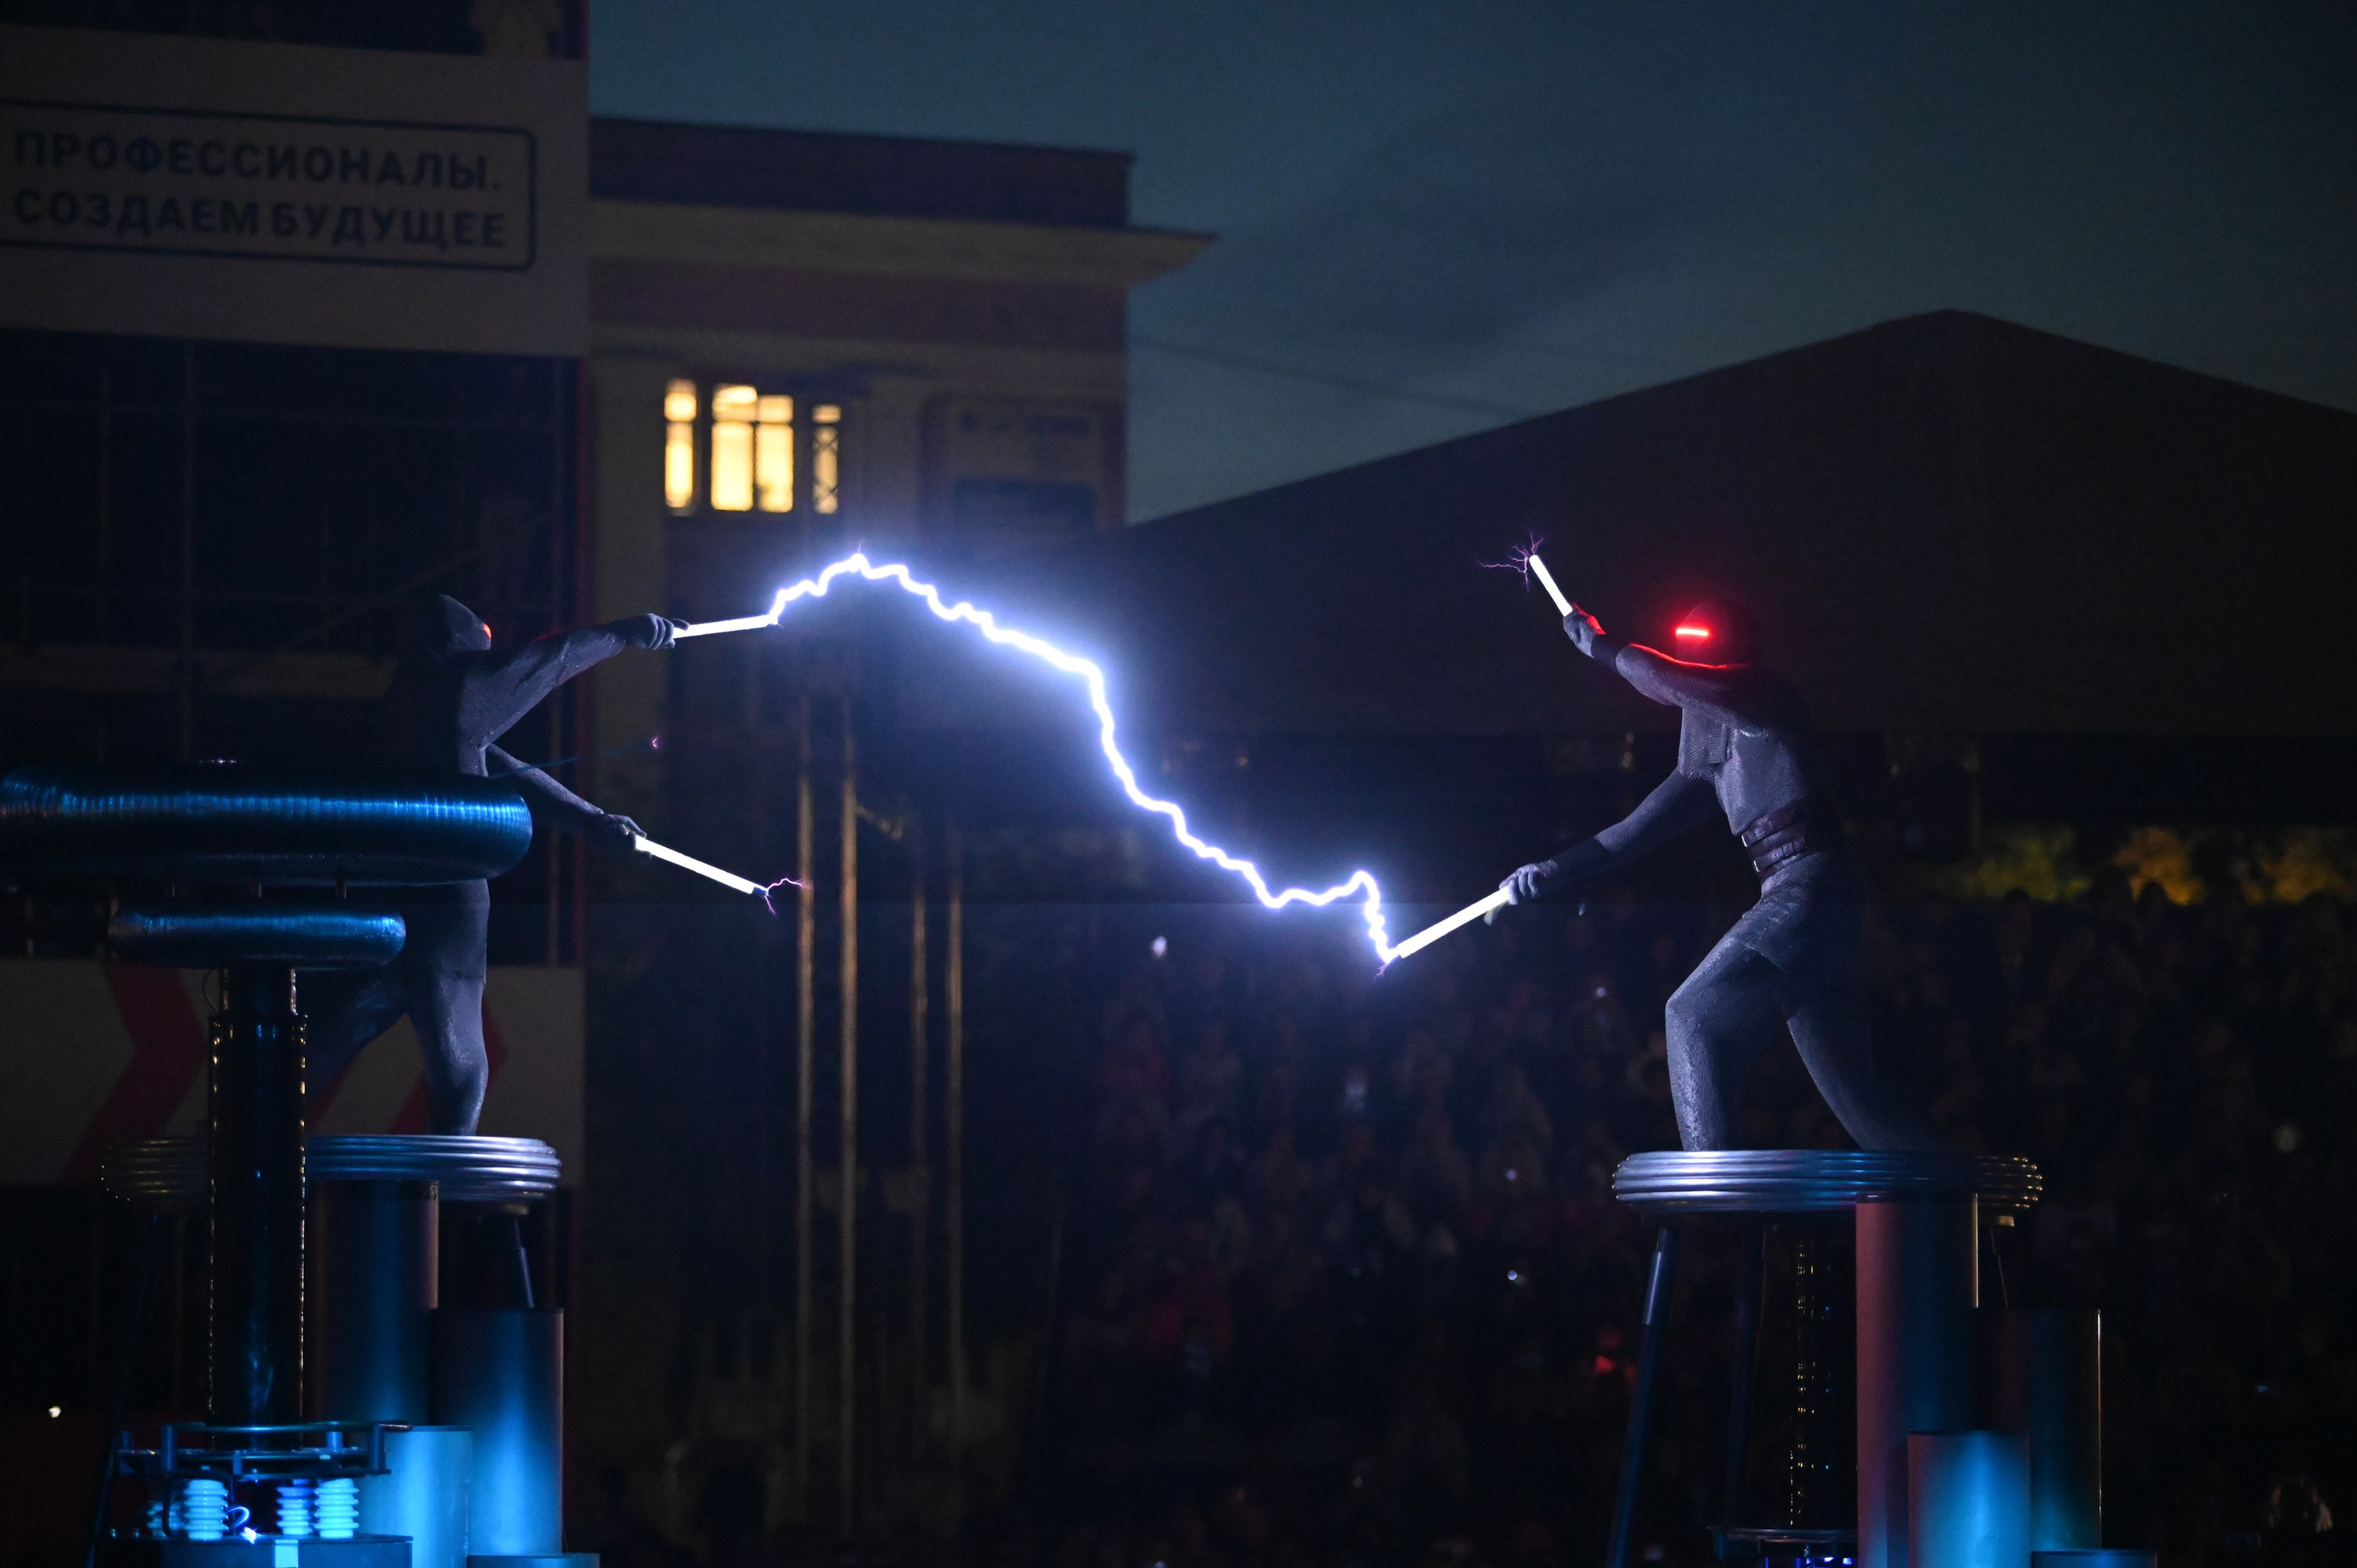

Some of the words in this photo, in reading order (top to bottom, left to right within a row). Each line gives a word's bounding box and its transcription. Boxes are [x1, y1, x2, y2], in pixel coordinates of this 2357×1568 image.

[13, 130, 502, 192] ПРОФЕССИОНАЛЫ.
[13, 188, 260, 237] СОЗДАЕМ
[273, 198, 506, 250] БУДУЩЕЕ
